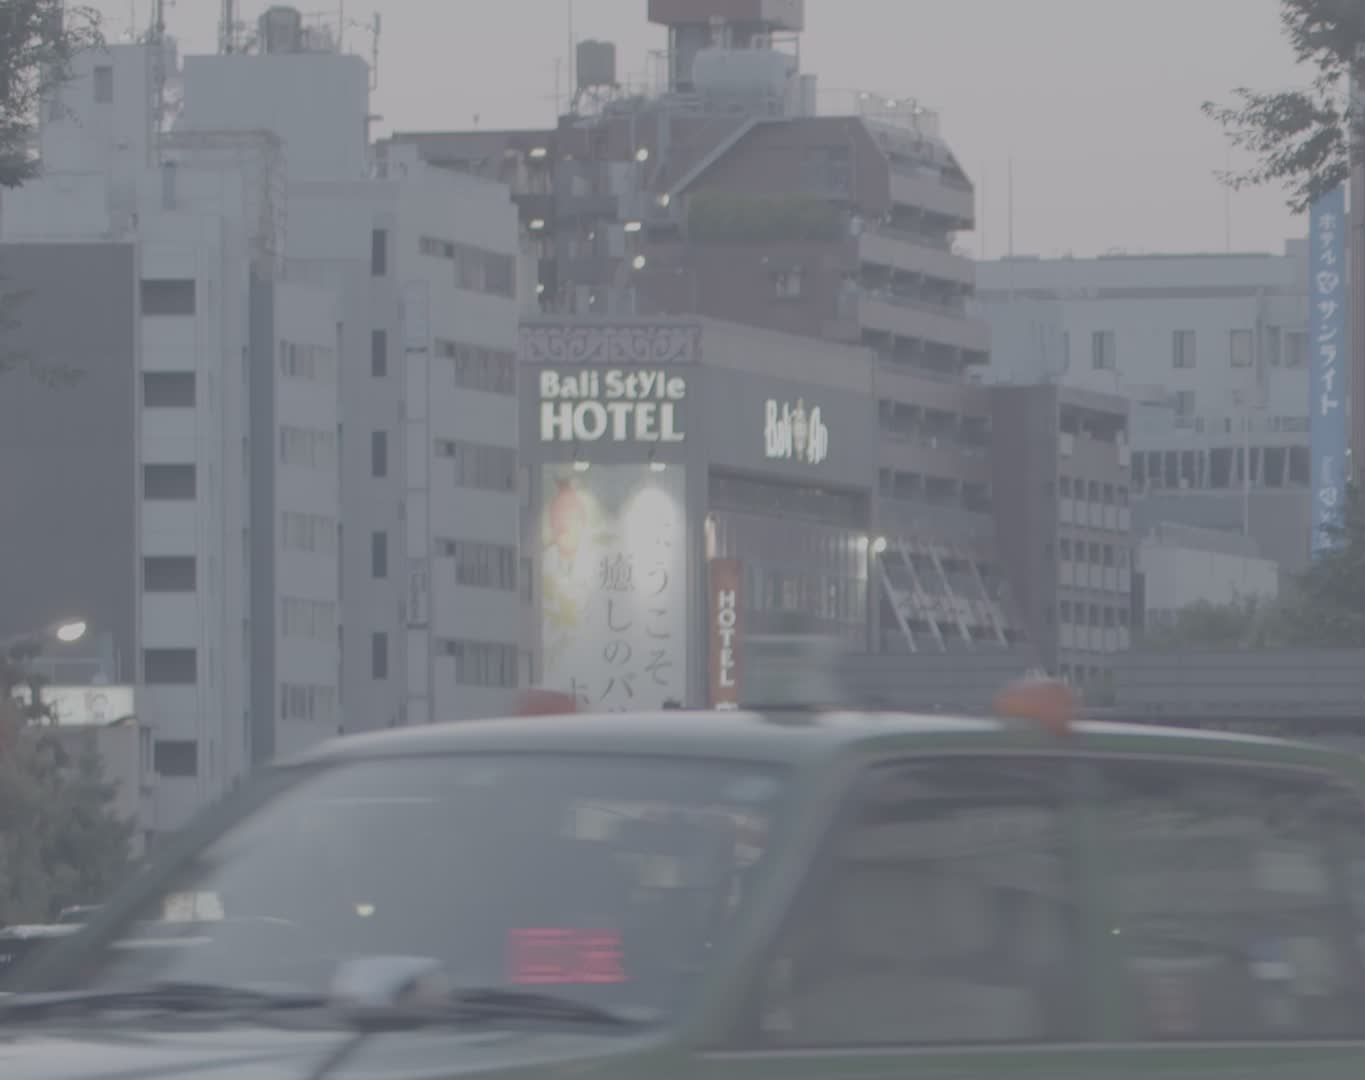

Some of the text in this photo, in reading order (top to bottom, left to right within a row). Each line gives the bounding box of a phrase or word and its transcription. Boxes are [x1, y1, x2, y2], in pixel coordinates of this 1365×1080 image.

[540, 370, 686, 399] Bali Style
[1317, 299, 1339, 416] サンライト
[540, 402, 686, 442] HOTEL
[599, 551, 637, 711] 癒しのバ
[717, 590, 736, 687] HOTEL
